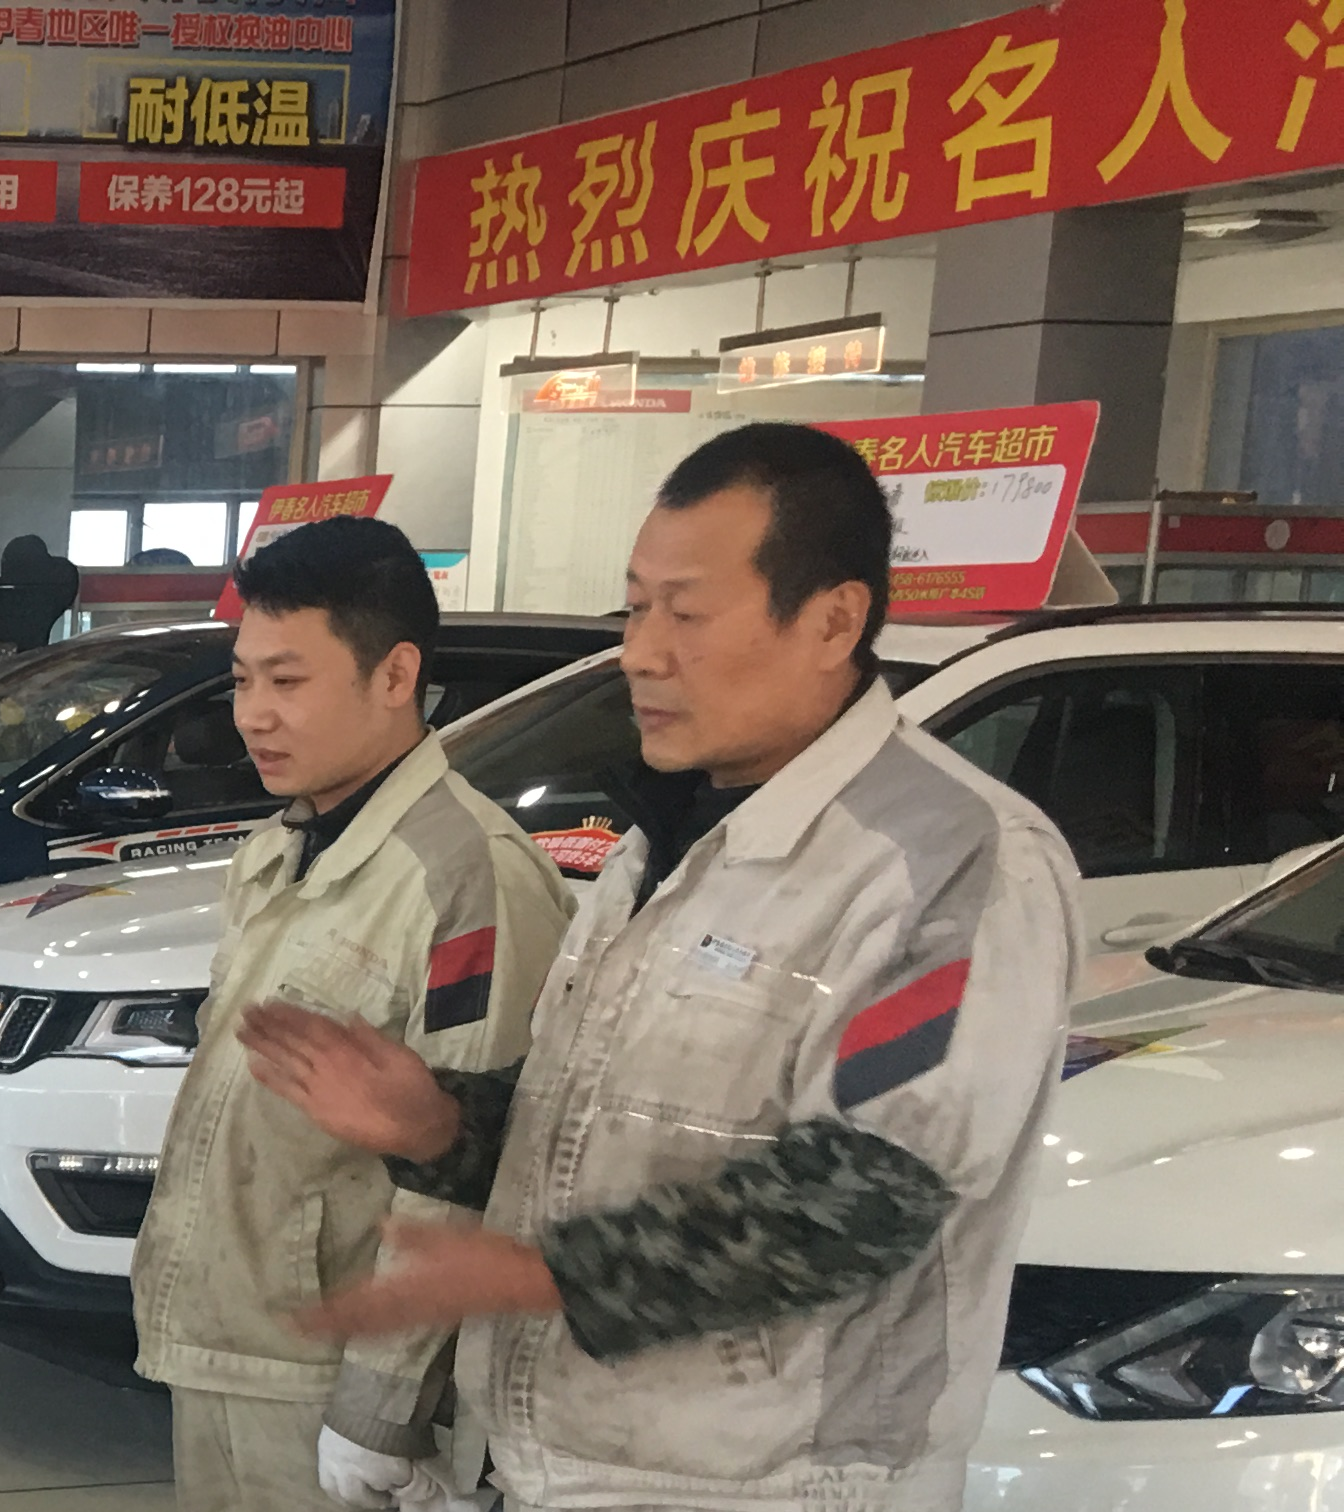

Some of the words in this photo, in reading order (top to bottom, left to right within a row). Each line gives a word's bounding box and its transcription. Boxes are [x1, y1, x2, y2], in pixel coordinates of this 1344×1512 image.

[127, 76, 310, 146] 耐低温
[107, 175, 304, 214] 保养128元起
[269, 490, 371, 521] 伊春名人汽车超市
[131, 841, 197, 858] RACING
